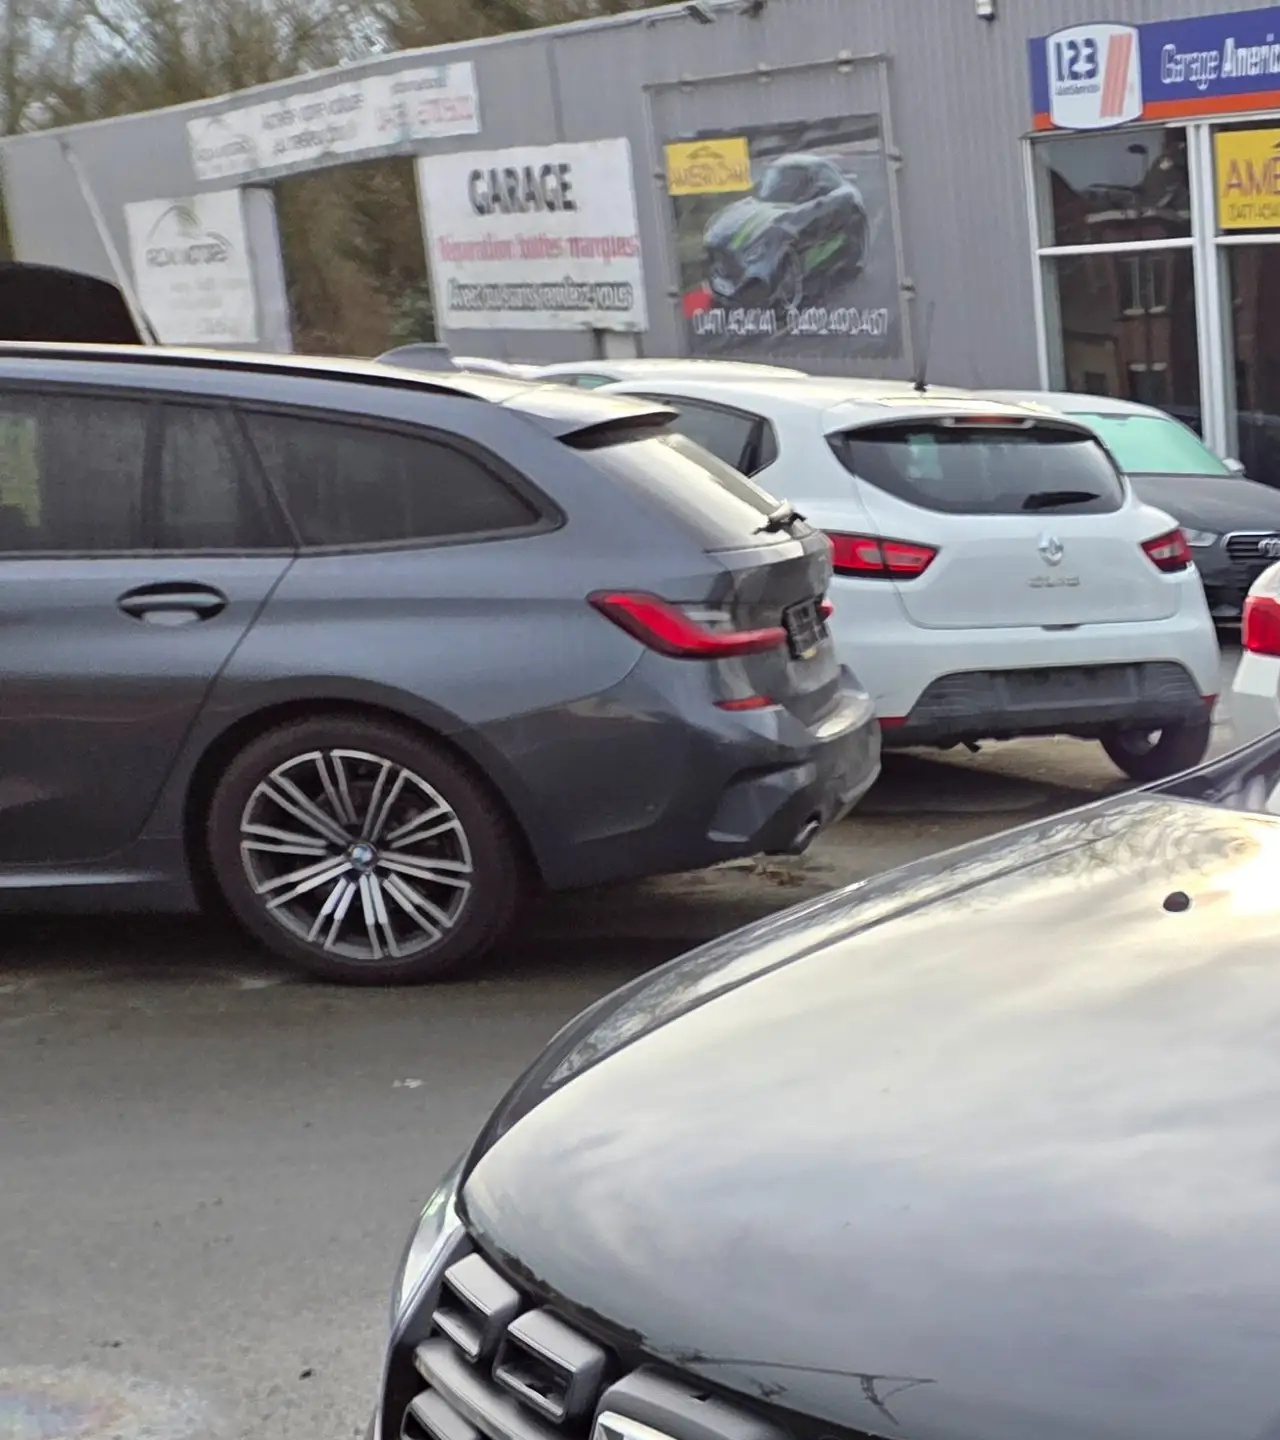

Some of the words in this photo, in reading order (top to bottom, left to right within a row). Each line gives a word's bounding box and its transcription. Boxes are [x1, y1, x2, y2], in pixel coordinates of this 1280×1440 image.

[1055, 38, 1098, 81] 123
[1161, 43, 1220, 90] Garage
[467, 163, 578, 216] GARAGE
